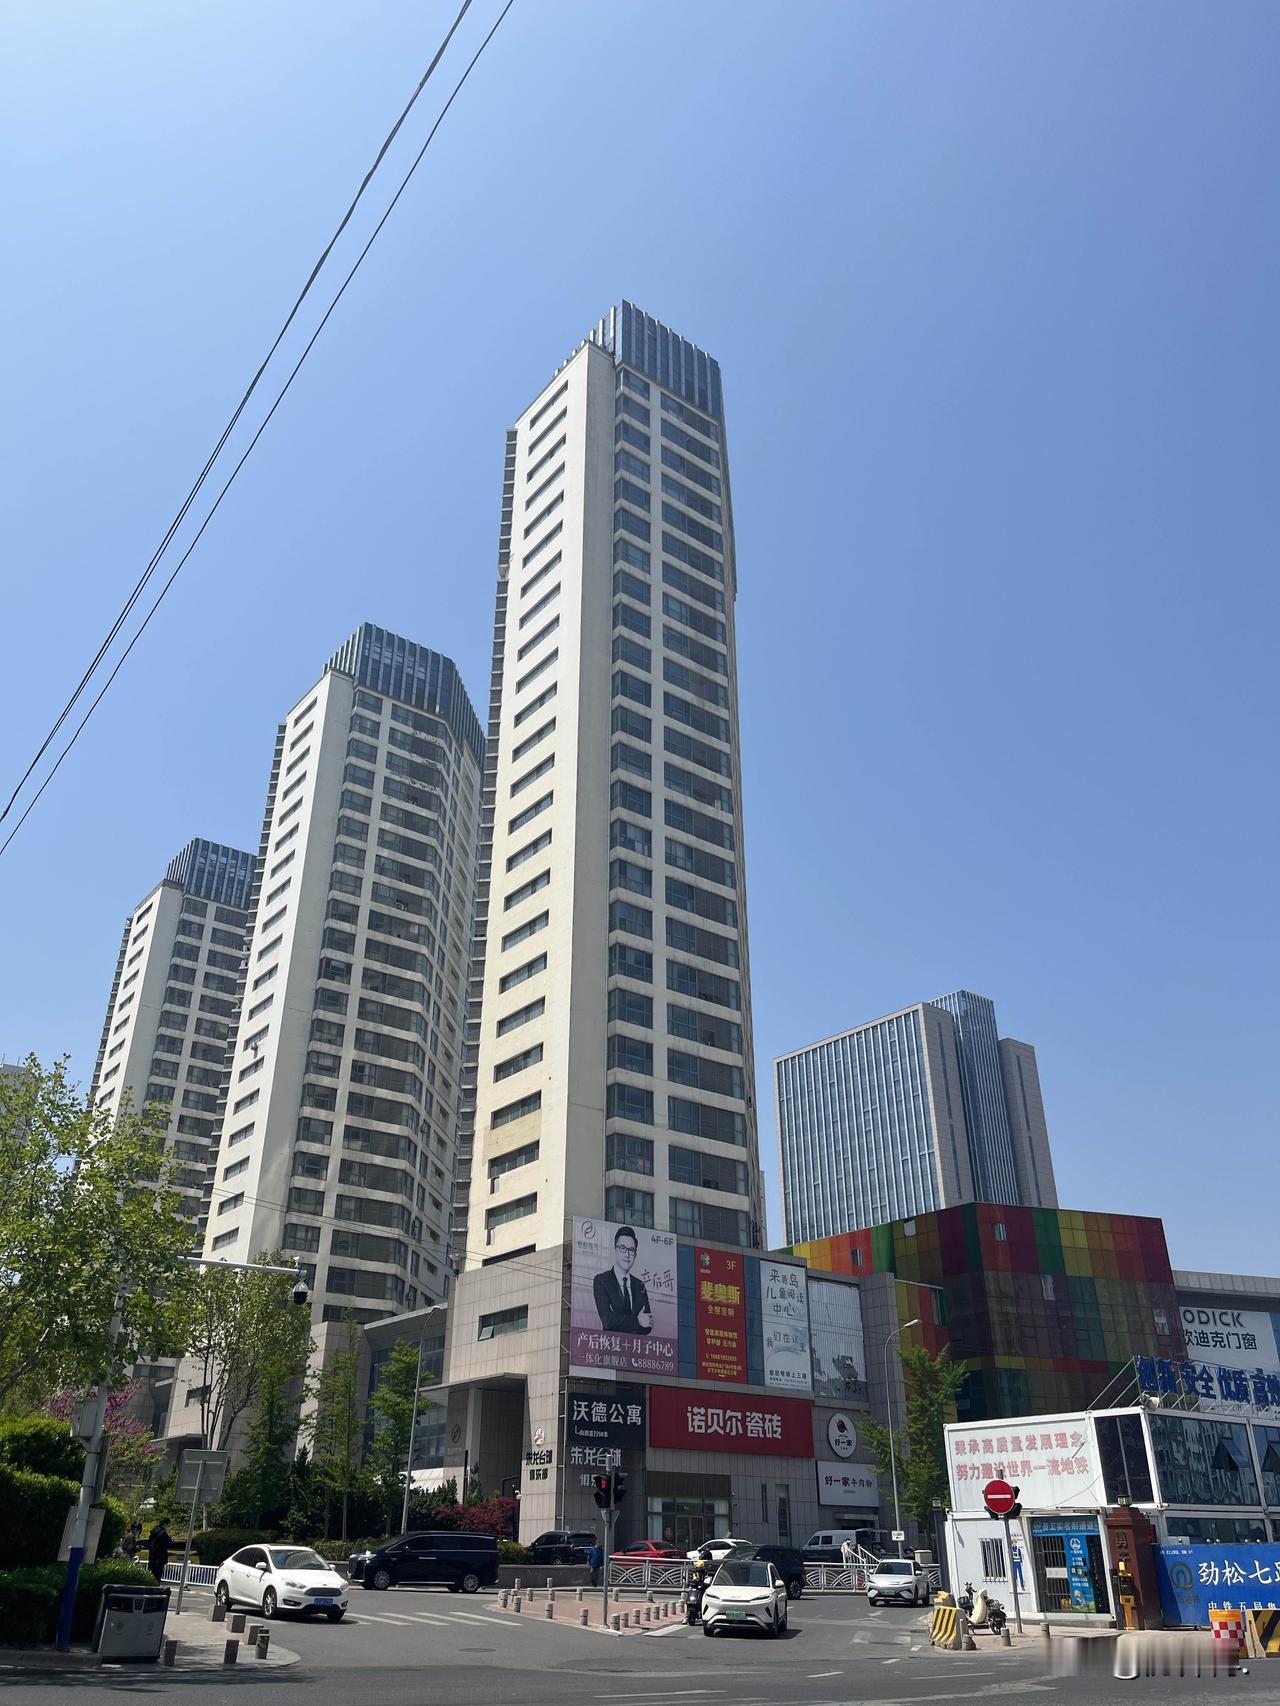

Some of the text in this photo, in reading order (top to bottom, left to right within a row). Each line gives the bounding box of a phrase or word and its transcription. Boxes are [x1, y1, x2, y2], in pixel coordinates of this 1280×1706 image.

[651, 1234, 674, 1246] 4F-6F
[726, 1260, 737, 1270] 3F
[772, 1302, 796, 1317] 中心
[576, 1331, 674, 1357] 产后恢复+月子中心
[638, 1358, 674, 1371] 88886789
[572, 1400, 642, 1426] 沃德公寓
[954, 1431, 1083, 1456] 秉承高质量发展理念
[955, 1456, 1090, 1481] 努力建设世界一流地铁
